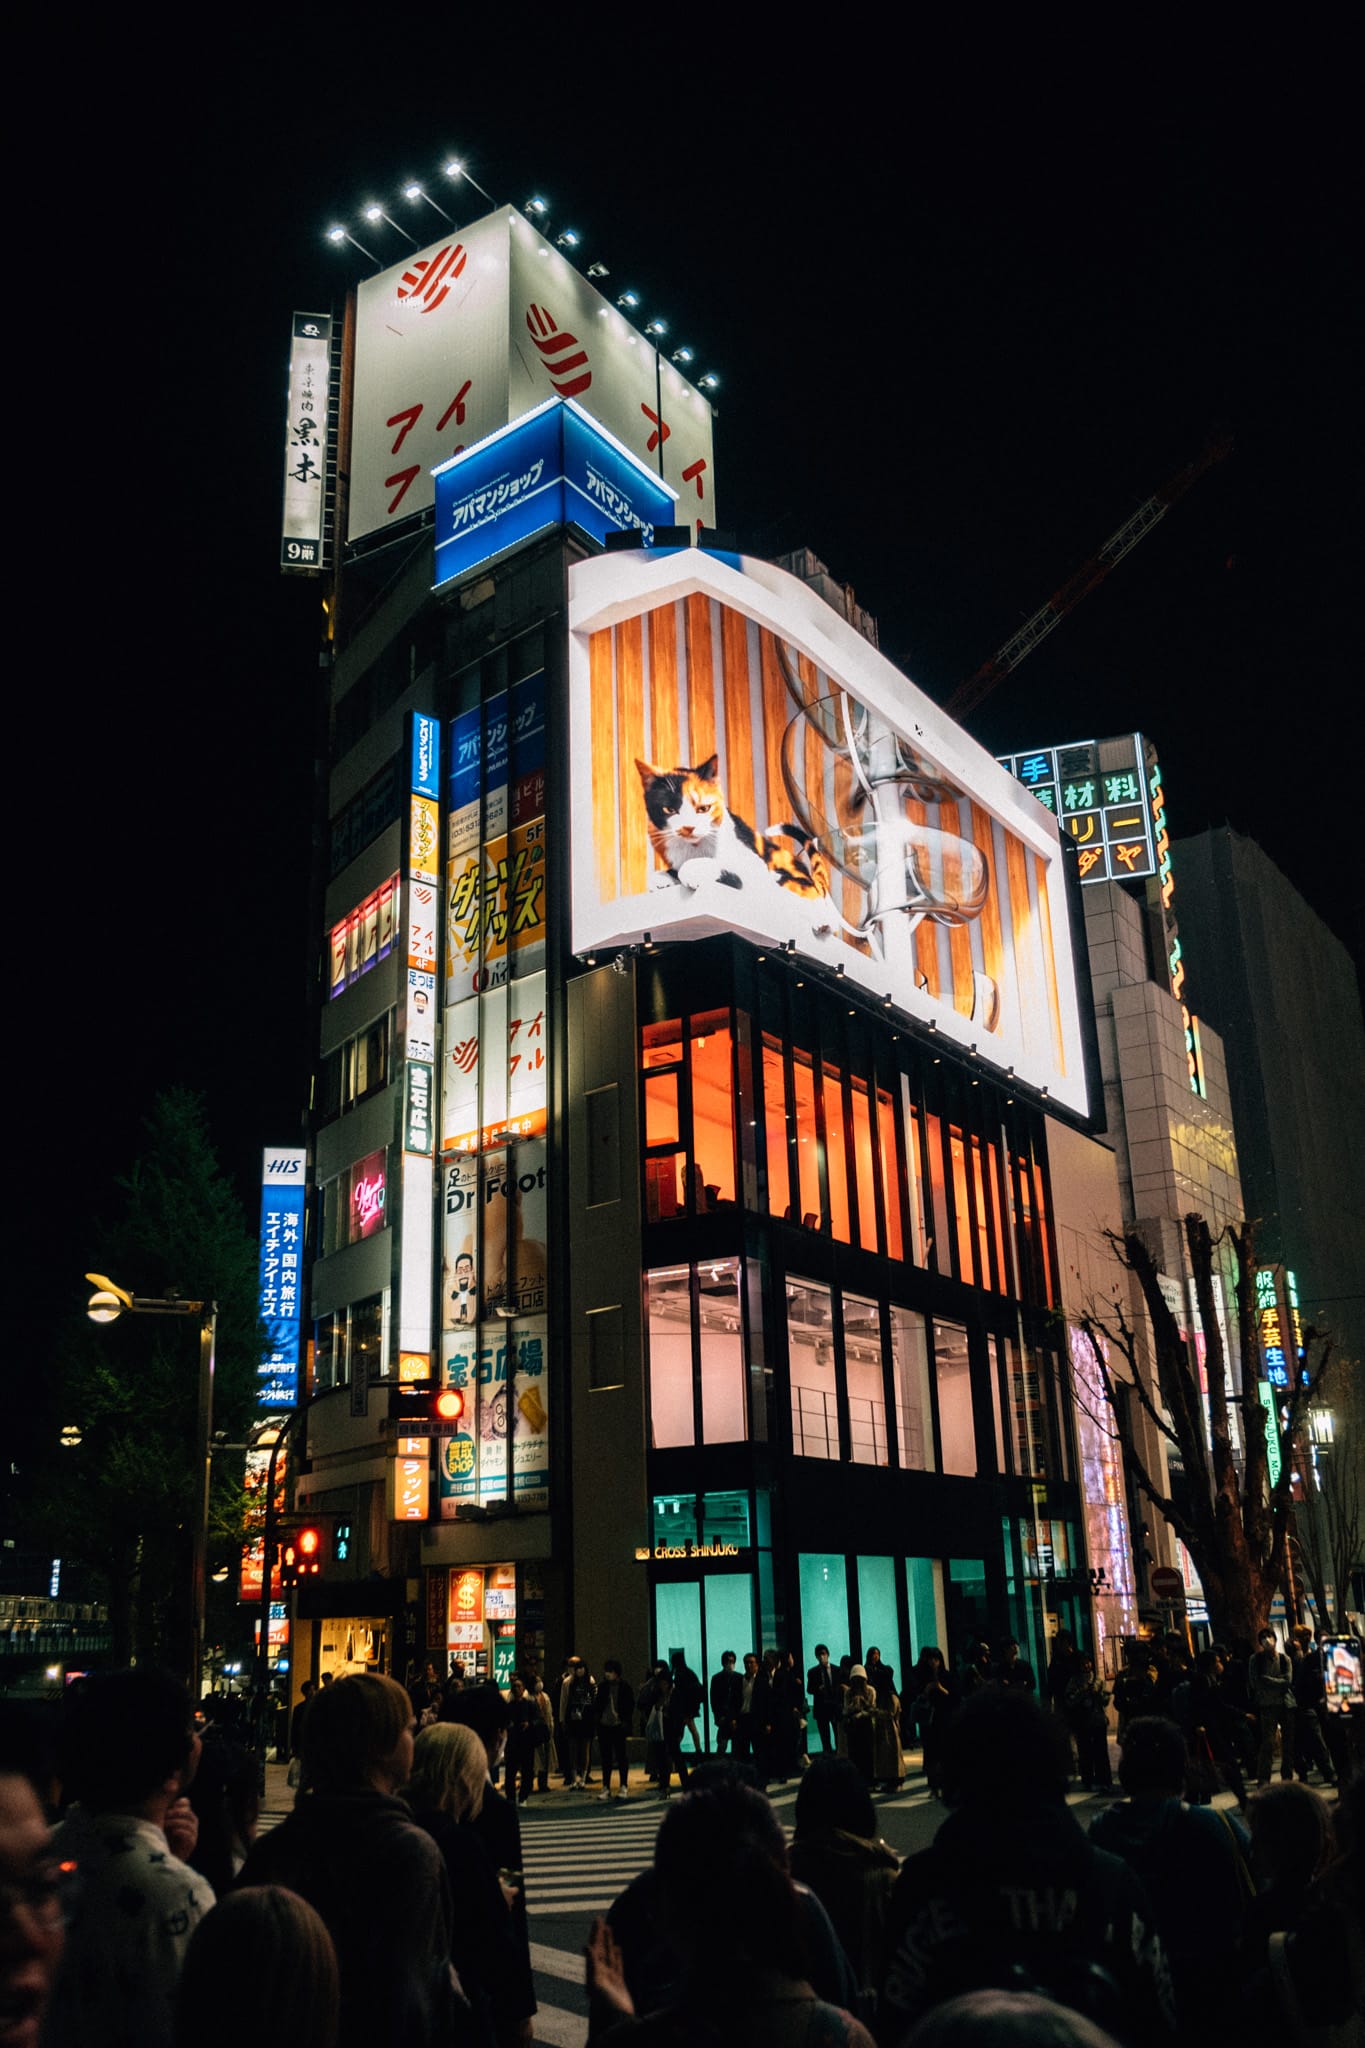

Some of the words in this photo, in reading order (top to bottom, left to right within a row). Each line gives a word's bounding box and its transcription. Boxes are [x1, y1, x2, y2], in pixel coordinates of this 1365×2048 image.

[386, 380, 472, 455] アイ
[288, 418, 322, 483] 黒木
[640, 402, 707, 500] アイ
[452, 459, 545, 530] アパマンショップ
[287, 543, 315, 561] 9階
[526, 823, 544, 844] 5F
[1077, 845, 1142, 877] ダヤ
[411, 925, 433, 941] アイ
[411, 941, 434, 955] フル
[415, 957, 429, 969] 4F
[509, 1011, 543, 1045] アイ
[509, 1048, 545, 1076] フル
[266, 1159, 301, 1174] HIS
[447, 1189, 475, 1215] Dr
[486, 1166, 546, 1204] Foot
[261, 1212, 281, 1317] エイチ・アイ・エス
[279, 1212, 299, 1318] 海外・国内旅行
[448, 1460, 474, 1474] SHOP
[654, 1546, 687, 1559] CROSS
[690, 1543, 739, 1558] SHINJUKU
